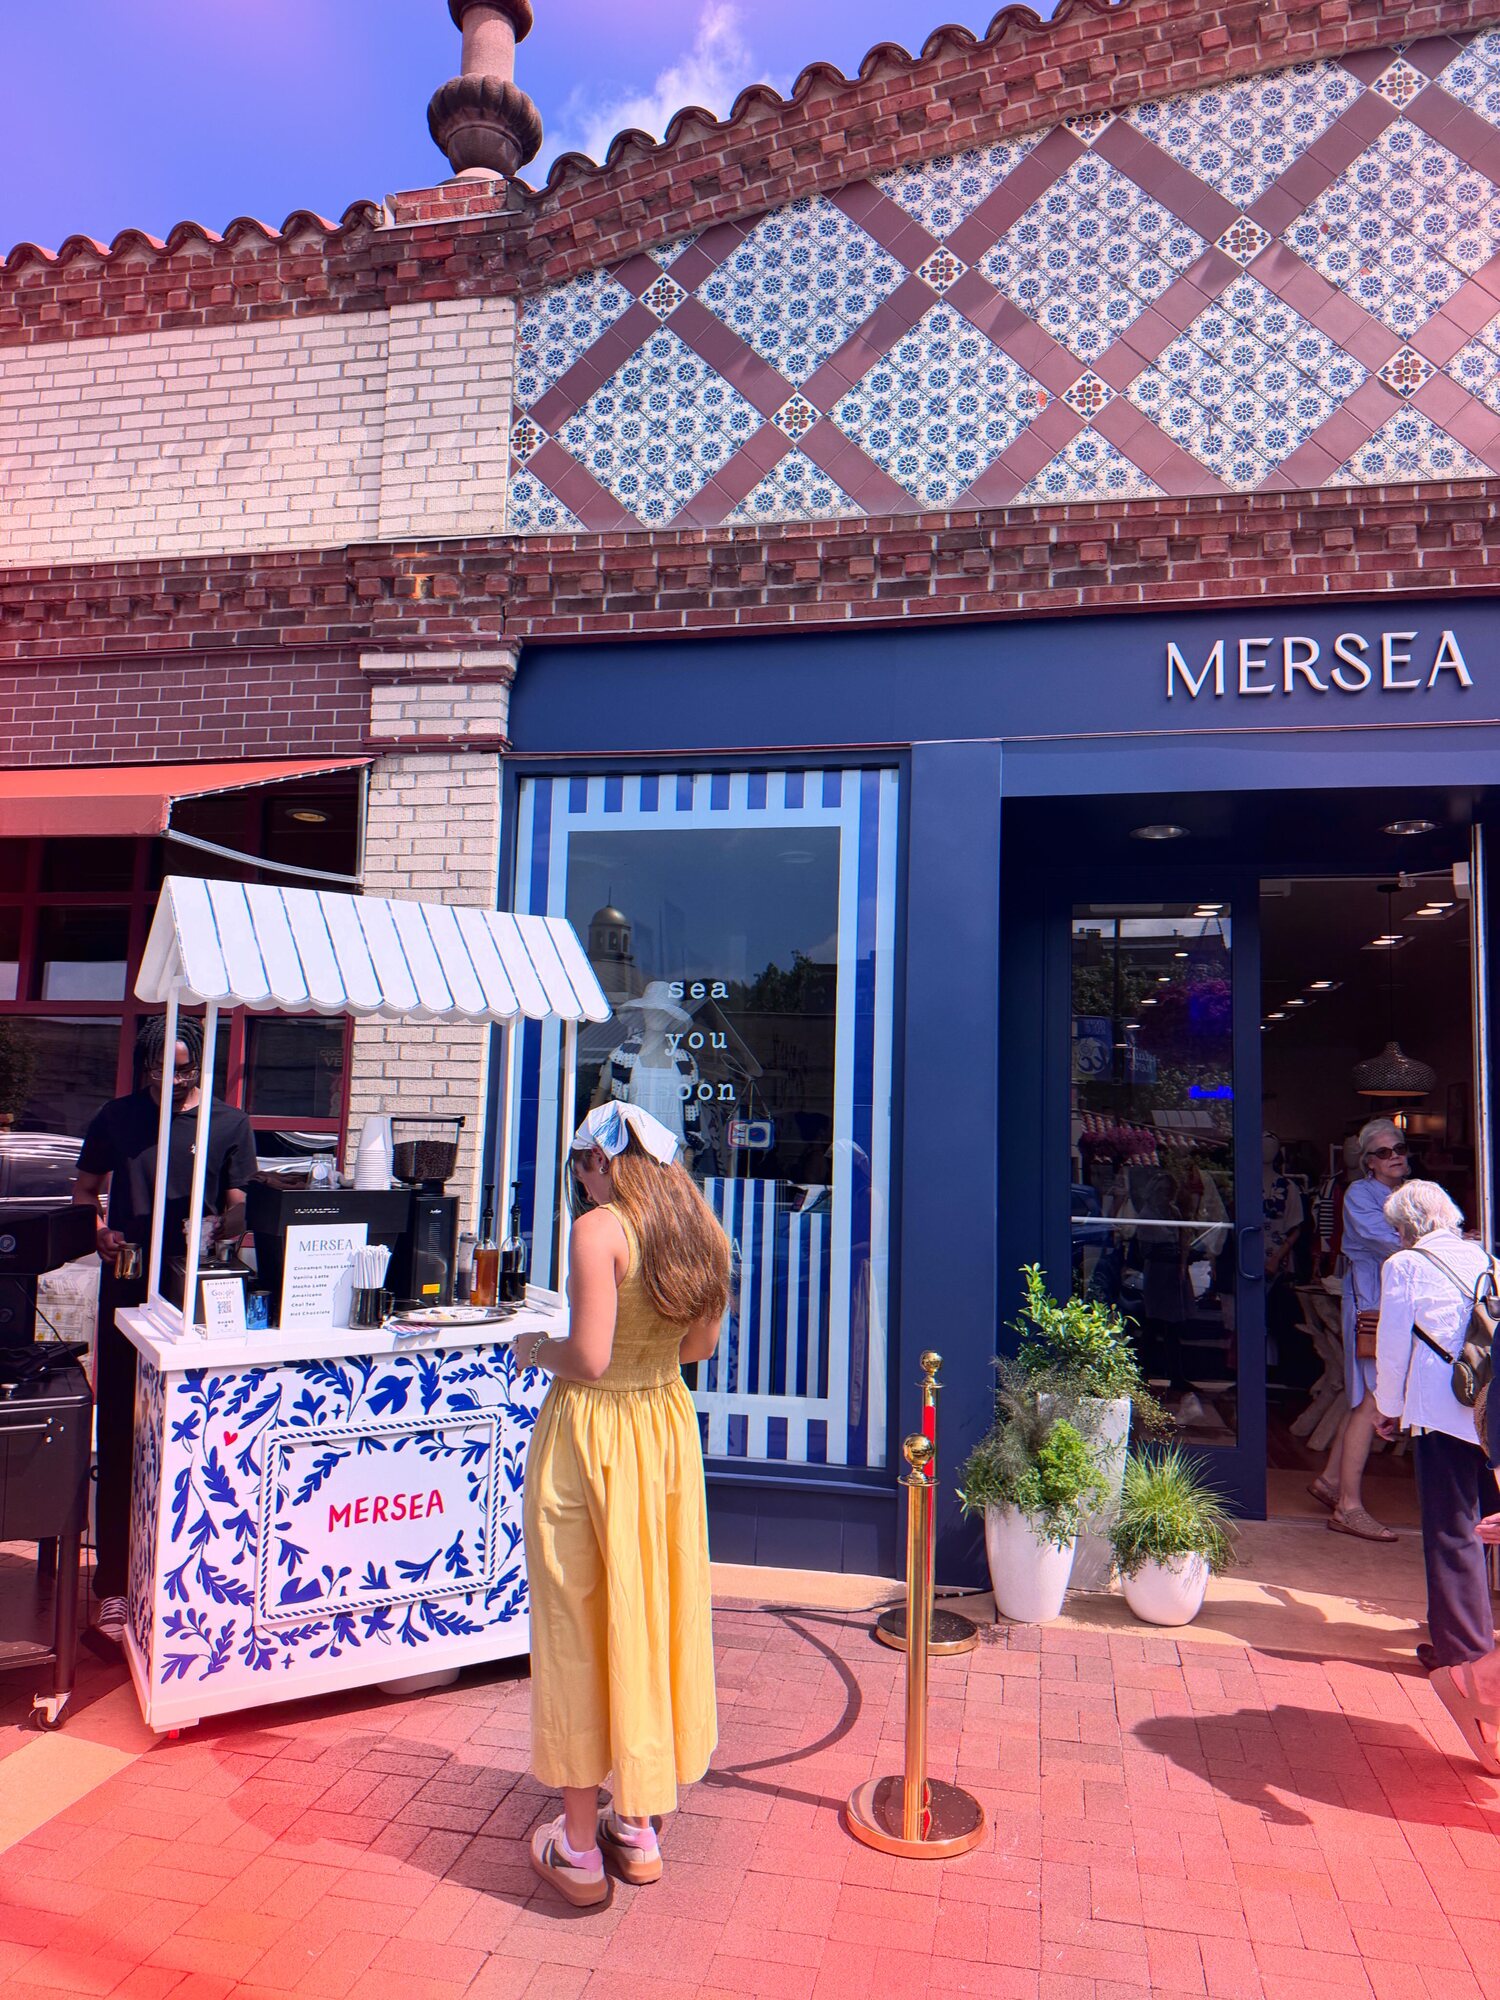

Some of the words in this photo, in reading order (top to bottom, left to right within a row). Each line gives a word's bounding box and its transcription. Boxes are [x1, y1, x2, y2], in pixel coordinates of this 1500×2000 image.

[1167, 630, 1474, 698] MERSEA
[667, 981, 729, 1000] sea
[665, 1031, 728, 1056] you
[672, 1083, 737, 1101] oon
[299, 1239, 354, 1252] MERSEA
[328, 1489, 444, 1533] MERSEA
